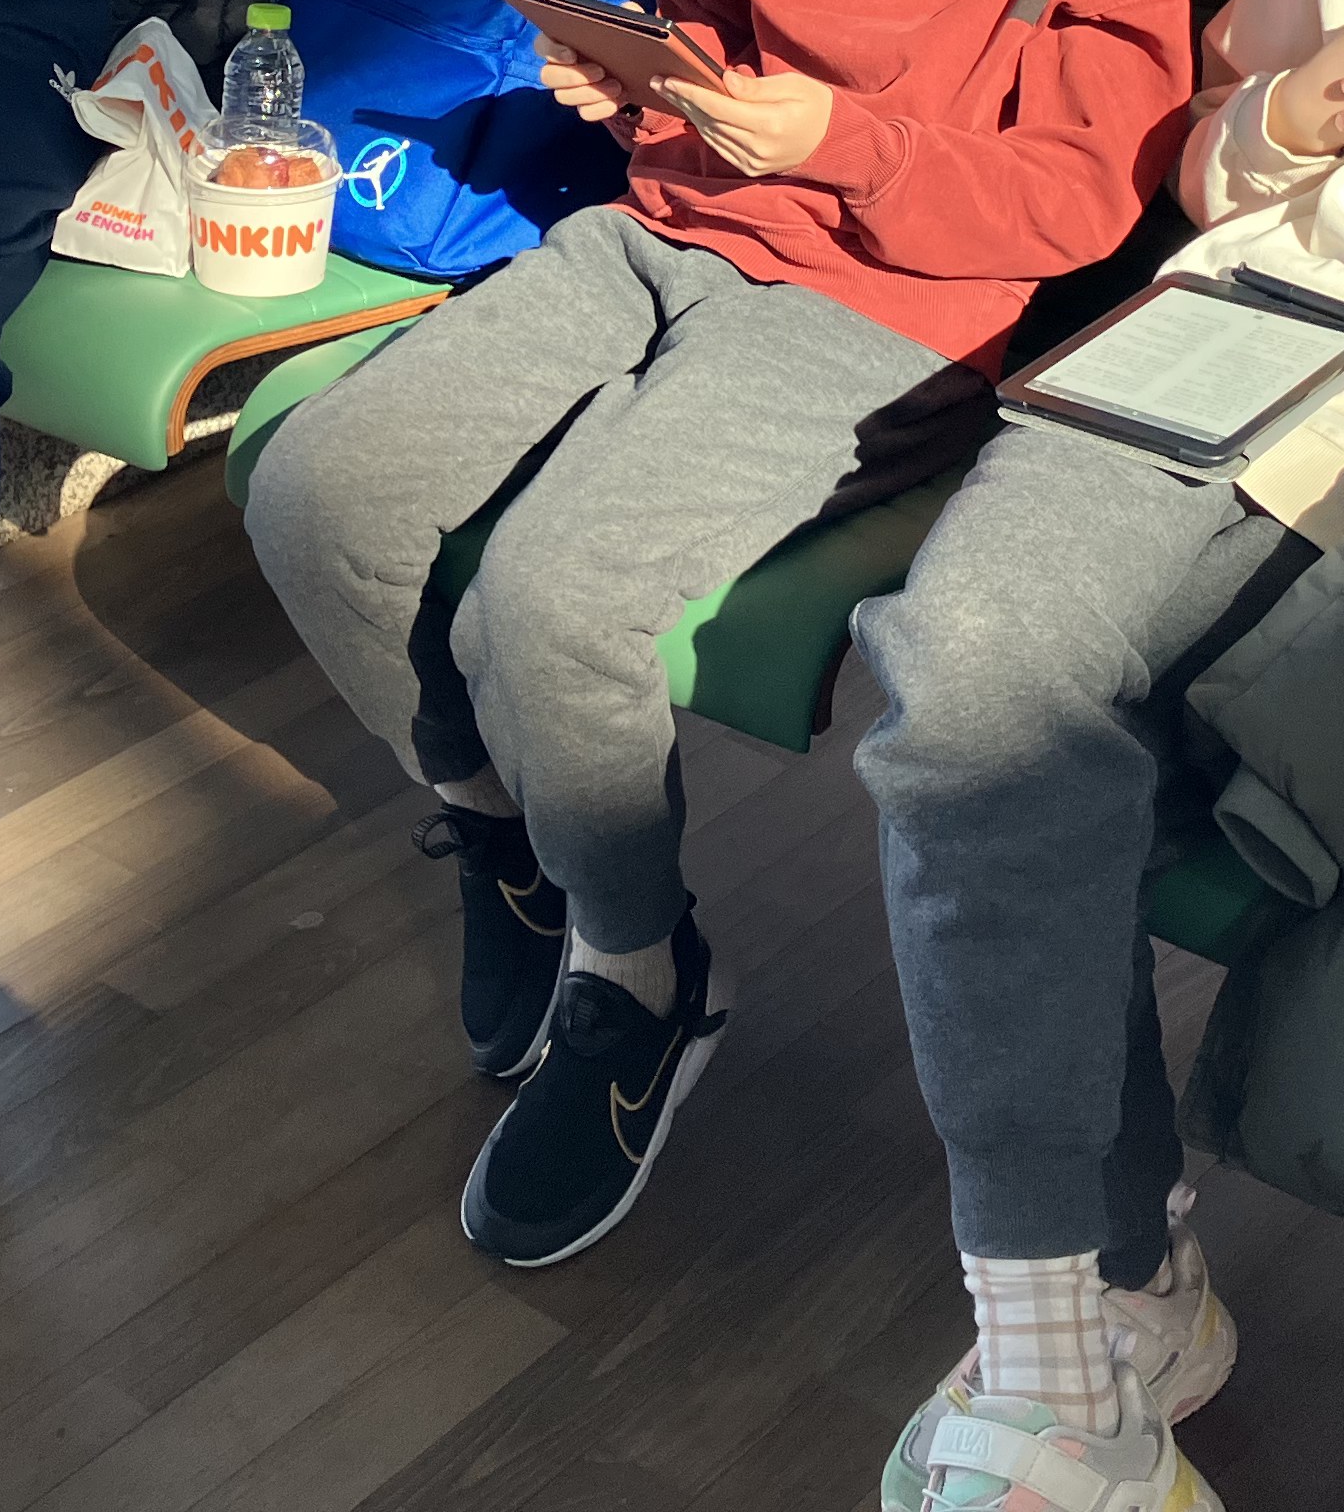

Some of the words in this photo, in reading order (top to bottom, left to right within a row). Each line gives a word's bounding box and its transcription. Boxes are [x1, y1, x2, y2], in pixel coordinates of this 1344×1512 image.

[75, 210, 91, 224] IS
[91, 214, 155, 241] ENOUGH
[193, 216, 324, 258] UNKIN'
